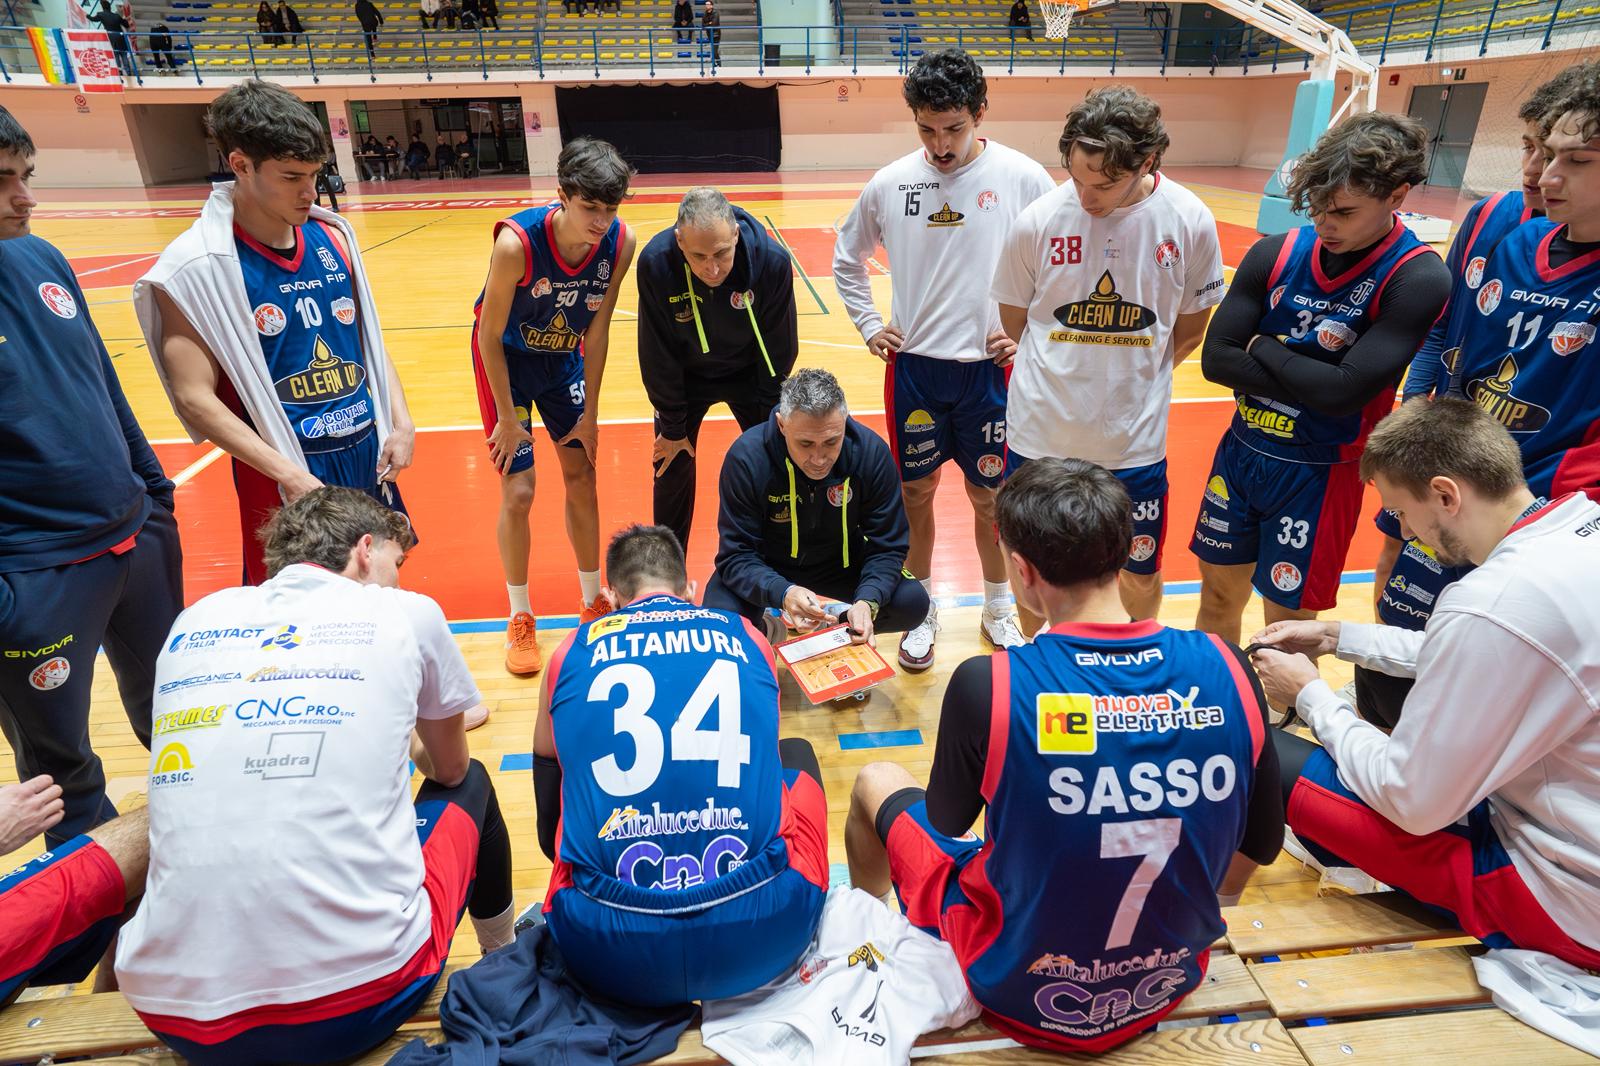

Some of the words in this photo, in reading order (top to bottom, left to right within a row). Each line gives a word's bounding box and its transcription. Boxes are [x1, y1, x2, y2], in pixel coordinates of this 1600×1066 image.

[905, 192, 921, 216] 15
[1050, 236, 1082, 266] 38
[326, 273, 346, 283] FIP
[552, 280, 588, 288] GIVOVA
[555, 290, 578, 307] 50
[1293, 295, 1337, 311] GIVOV
[295, 296, 323, 329] 10
[1067, 304, 1115, 328] CLEAN
[1119, 307, 1141, 328] UP
[1337, 303, 1363, 317] FIP
[527, 330, 565, 349] CLEAN
[1058, 333, 1102, 344] CLEANING
[1113, 336, 1150, 347] SERVITO
[1507, 312, 1544, 350] 11
[289, 368, 344, 399] CLEAN
[323, 400, 368, 424] CONTACT
[982, 420, 1006, 443] 15
[905, 451, 940, 468] GIVOVA
[1132, 499, 1160, 521] 38
[1277, 516, 1309, 549] 33
[189, 628, 265, 641] CONTACT
[309, 630, 376, 638] MECCANICHE
[312, 622, 377, 631] LAVORAZIONI
[5, 634, 75, 658] GIVOVA
[185, 640, 215, 650] ITALIA
[318, 638, 374, 646] PRECISIONE
[590, 629, 749, 668] ALTAMURA
[1075, 648, 1164, 667] GIVOVA
[162, 704, 227, 730] TELMES
[235, 696, 306, 720] CNC
[305, 705, 340, 716] PRO
[242, 720, 286, 728] MECCANICA
[298, 718, 342, 726] PRECISIONE
[587, 659, 750, 797] 34
[244, 754, 310, 769] kuadra
[152, 772, 194, 786] FOR.SIC.
[1048, 754, 1236, 815] SASSO
[1100, 818, 1182, 951] 7
